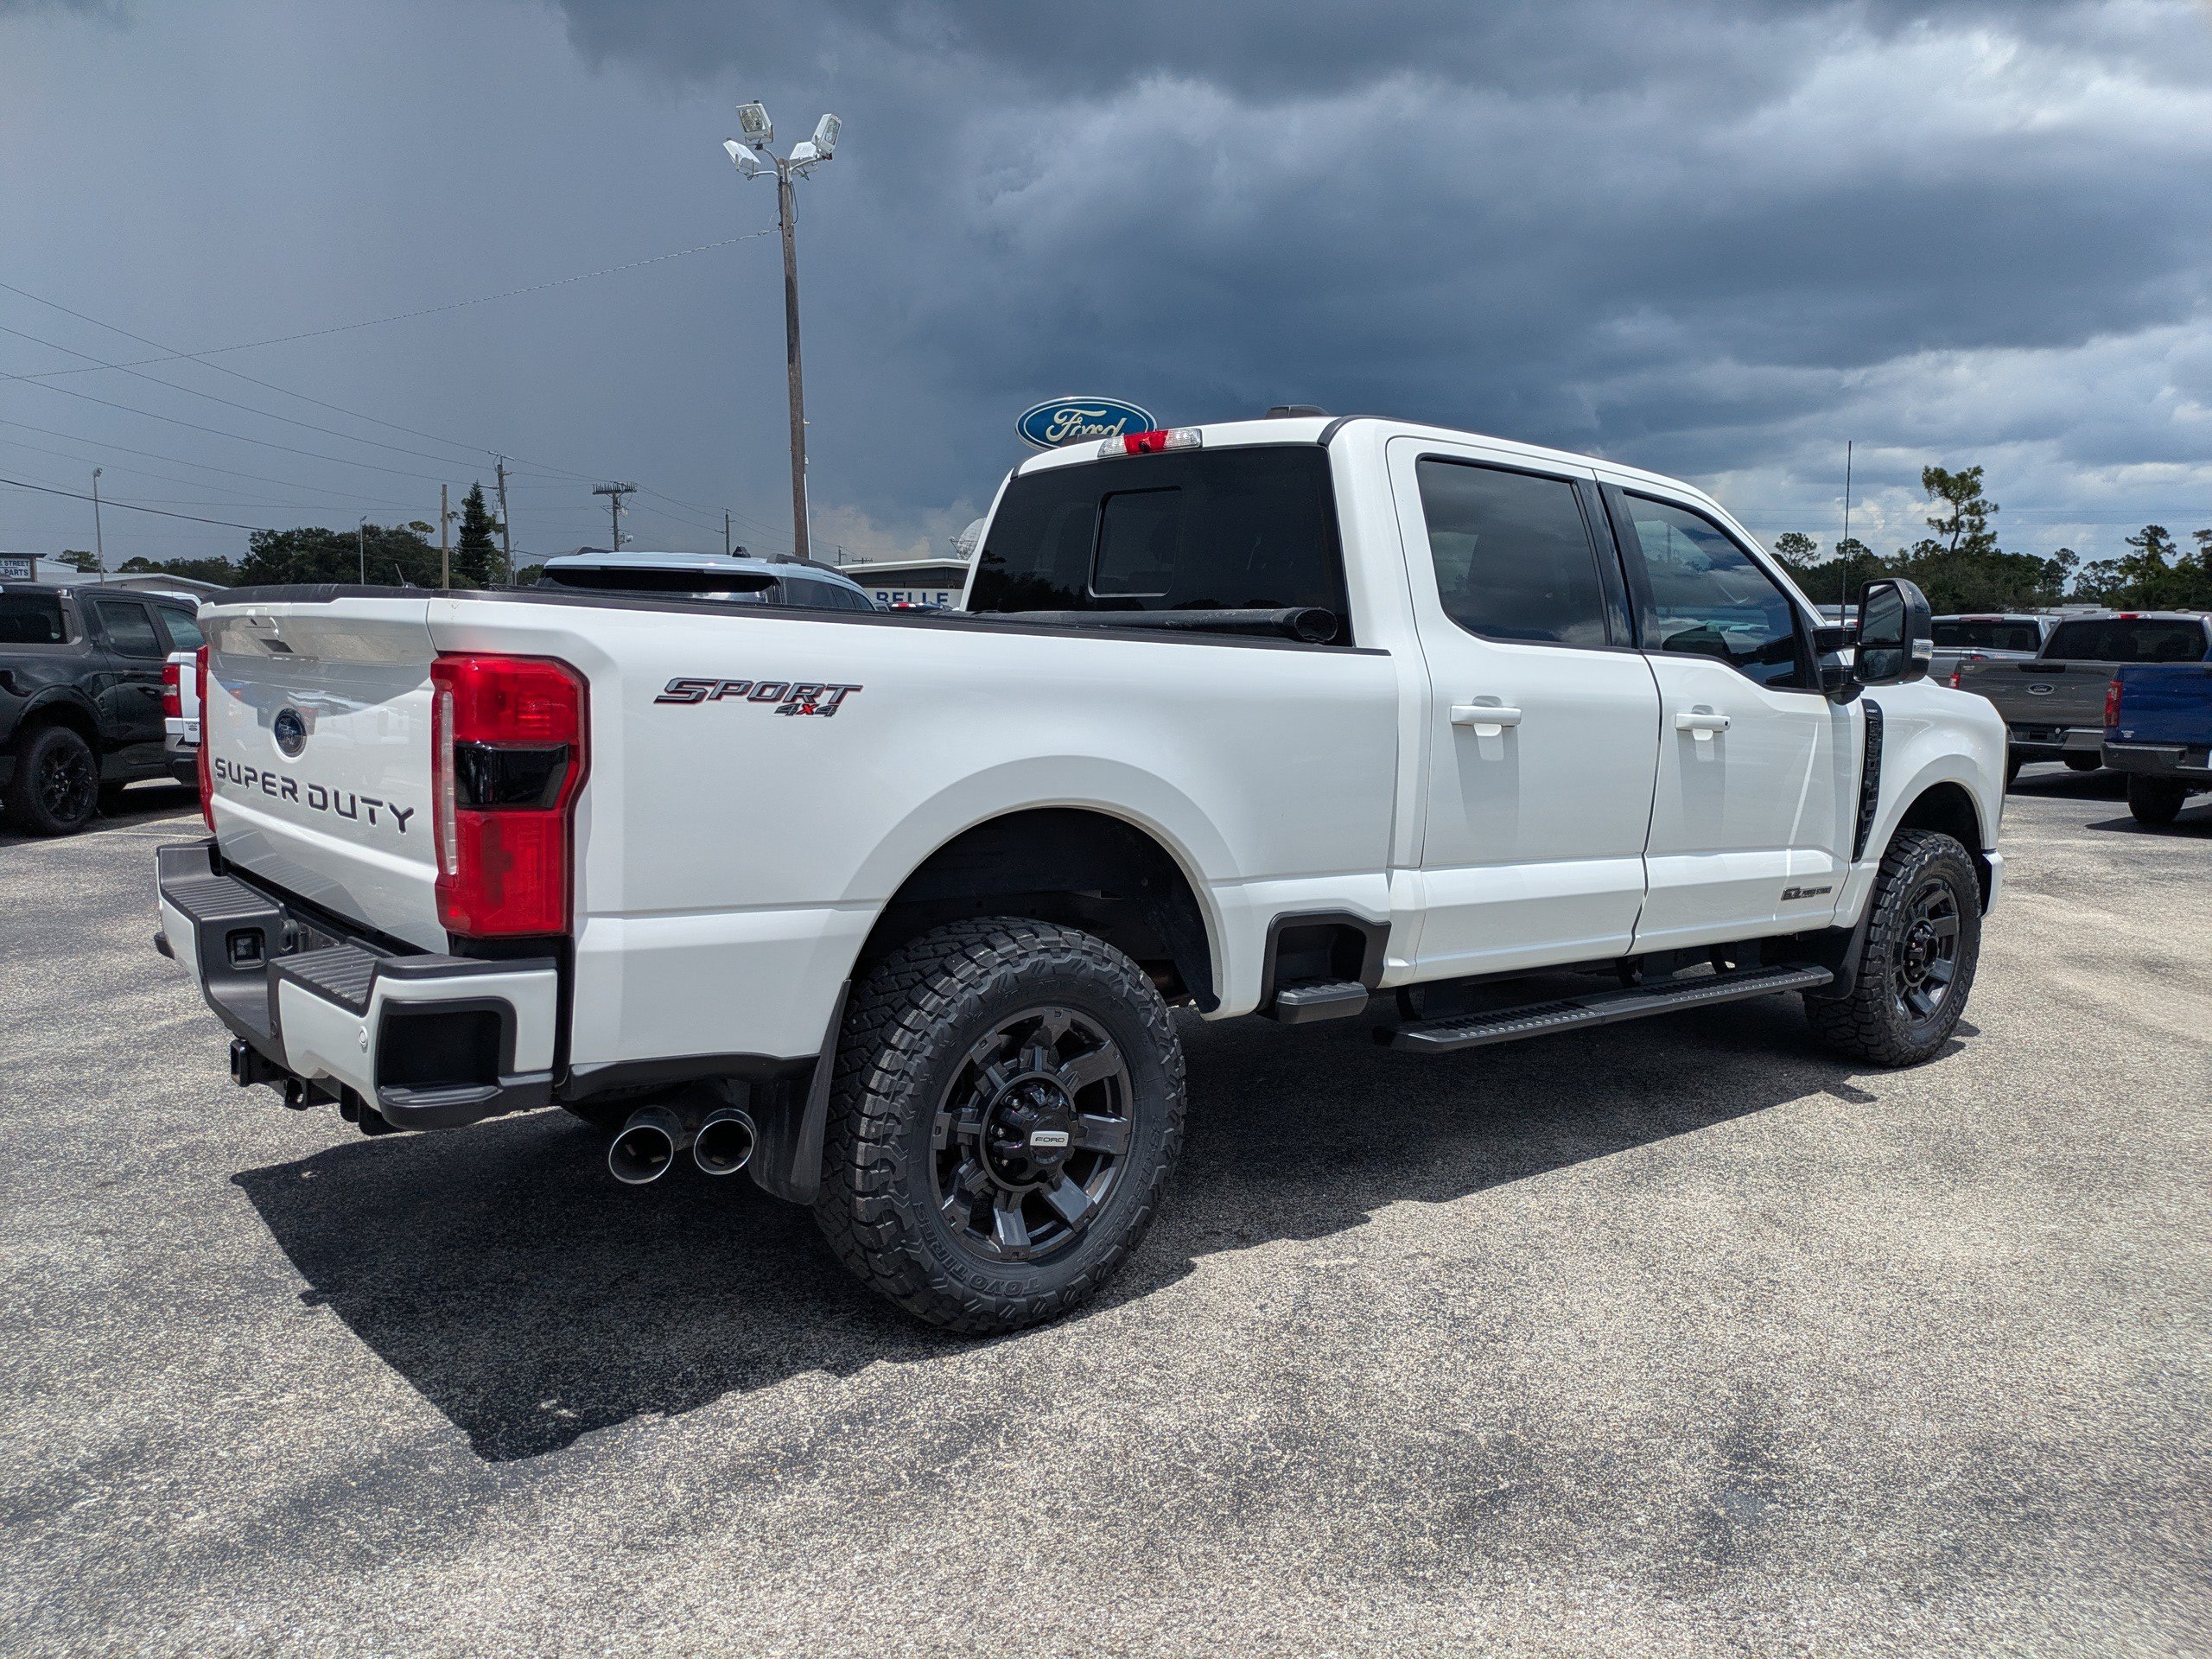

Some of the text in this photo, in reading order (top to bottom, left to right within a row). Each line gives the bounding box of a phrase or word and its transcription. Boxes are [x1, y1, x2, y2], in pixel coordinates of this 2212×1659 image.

[1046, 408, 1127, 442] Ford
[653, 677, 864, 704] SPORT
[215, 757, 415, 835] SUPER DUTY
[912, 1201, 1041, 1297] TOYO TIRES
